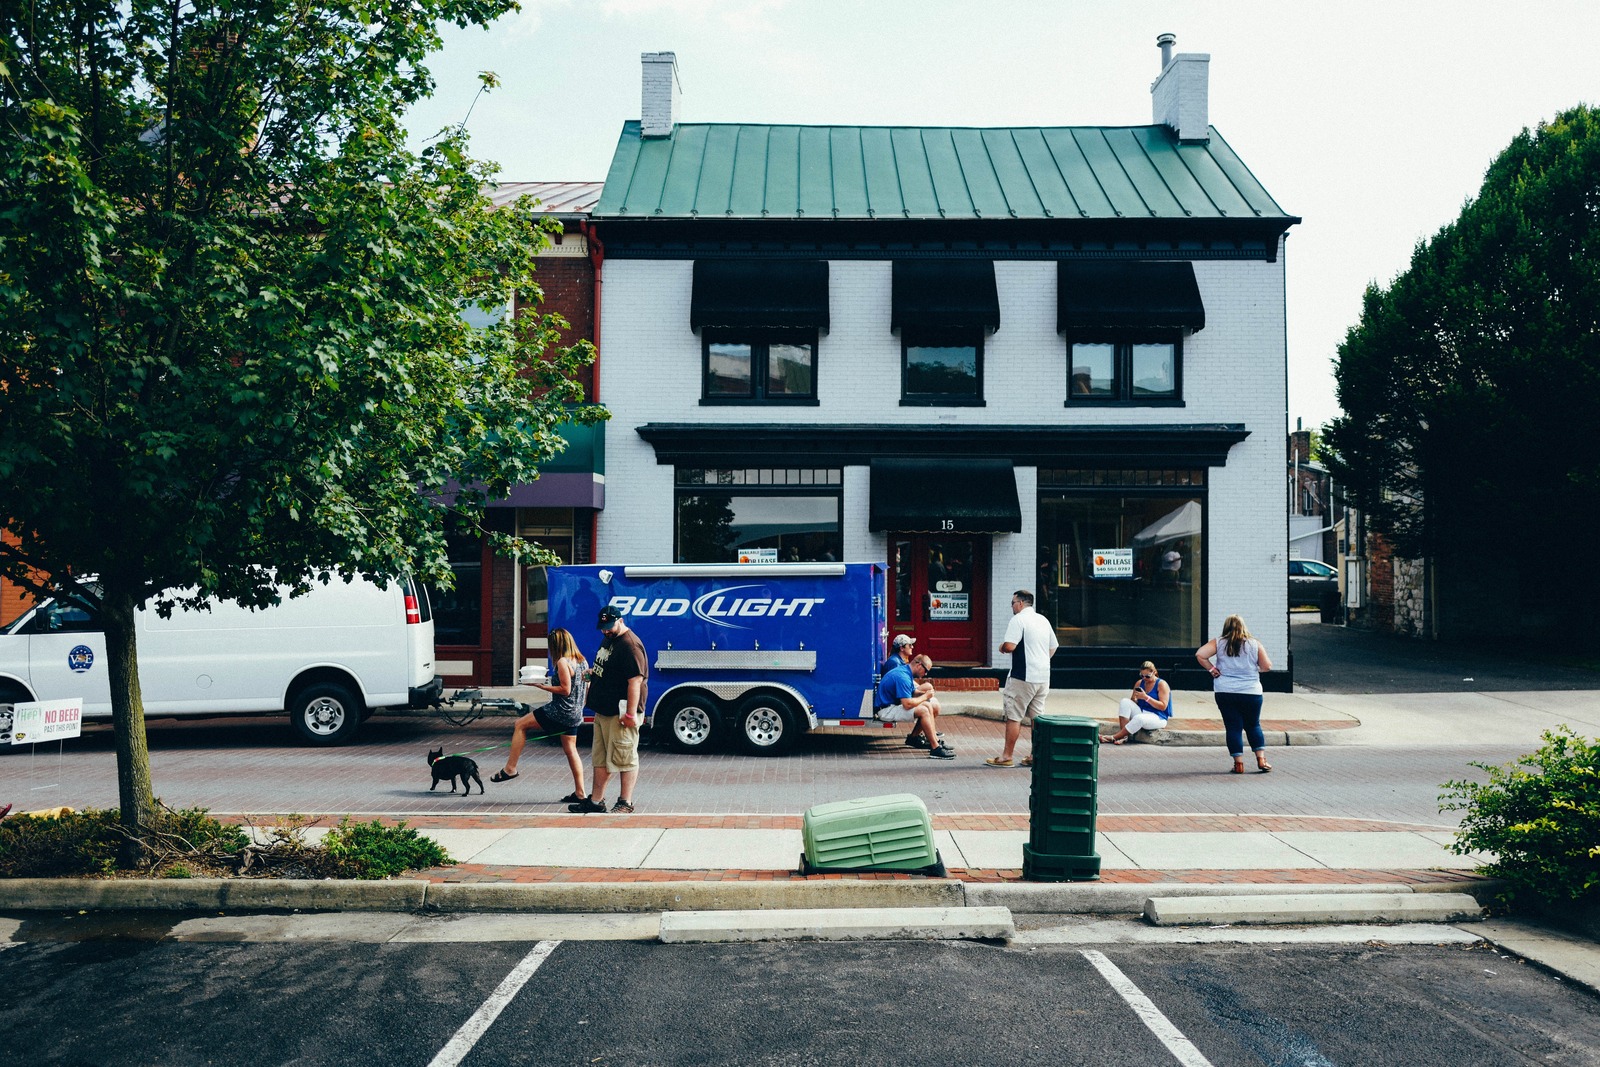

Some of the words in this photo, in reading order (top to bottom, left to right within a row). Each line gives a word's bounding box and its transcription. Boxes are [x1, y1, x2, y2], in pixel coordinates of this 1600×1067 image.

[941, 519, 954, 530] 15
[608, 596, 690, 616] BUD
[706, 596, 825, 617] LIGHT
[44, 710, 57, 723] NO
[58, 708, 79, 722] BEER
[43, 724, 56, 733] PAST
[55, 723, 66, 732] THIS
[65, 722, 79, 731] POINT
